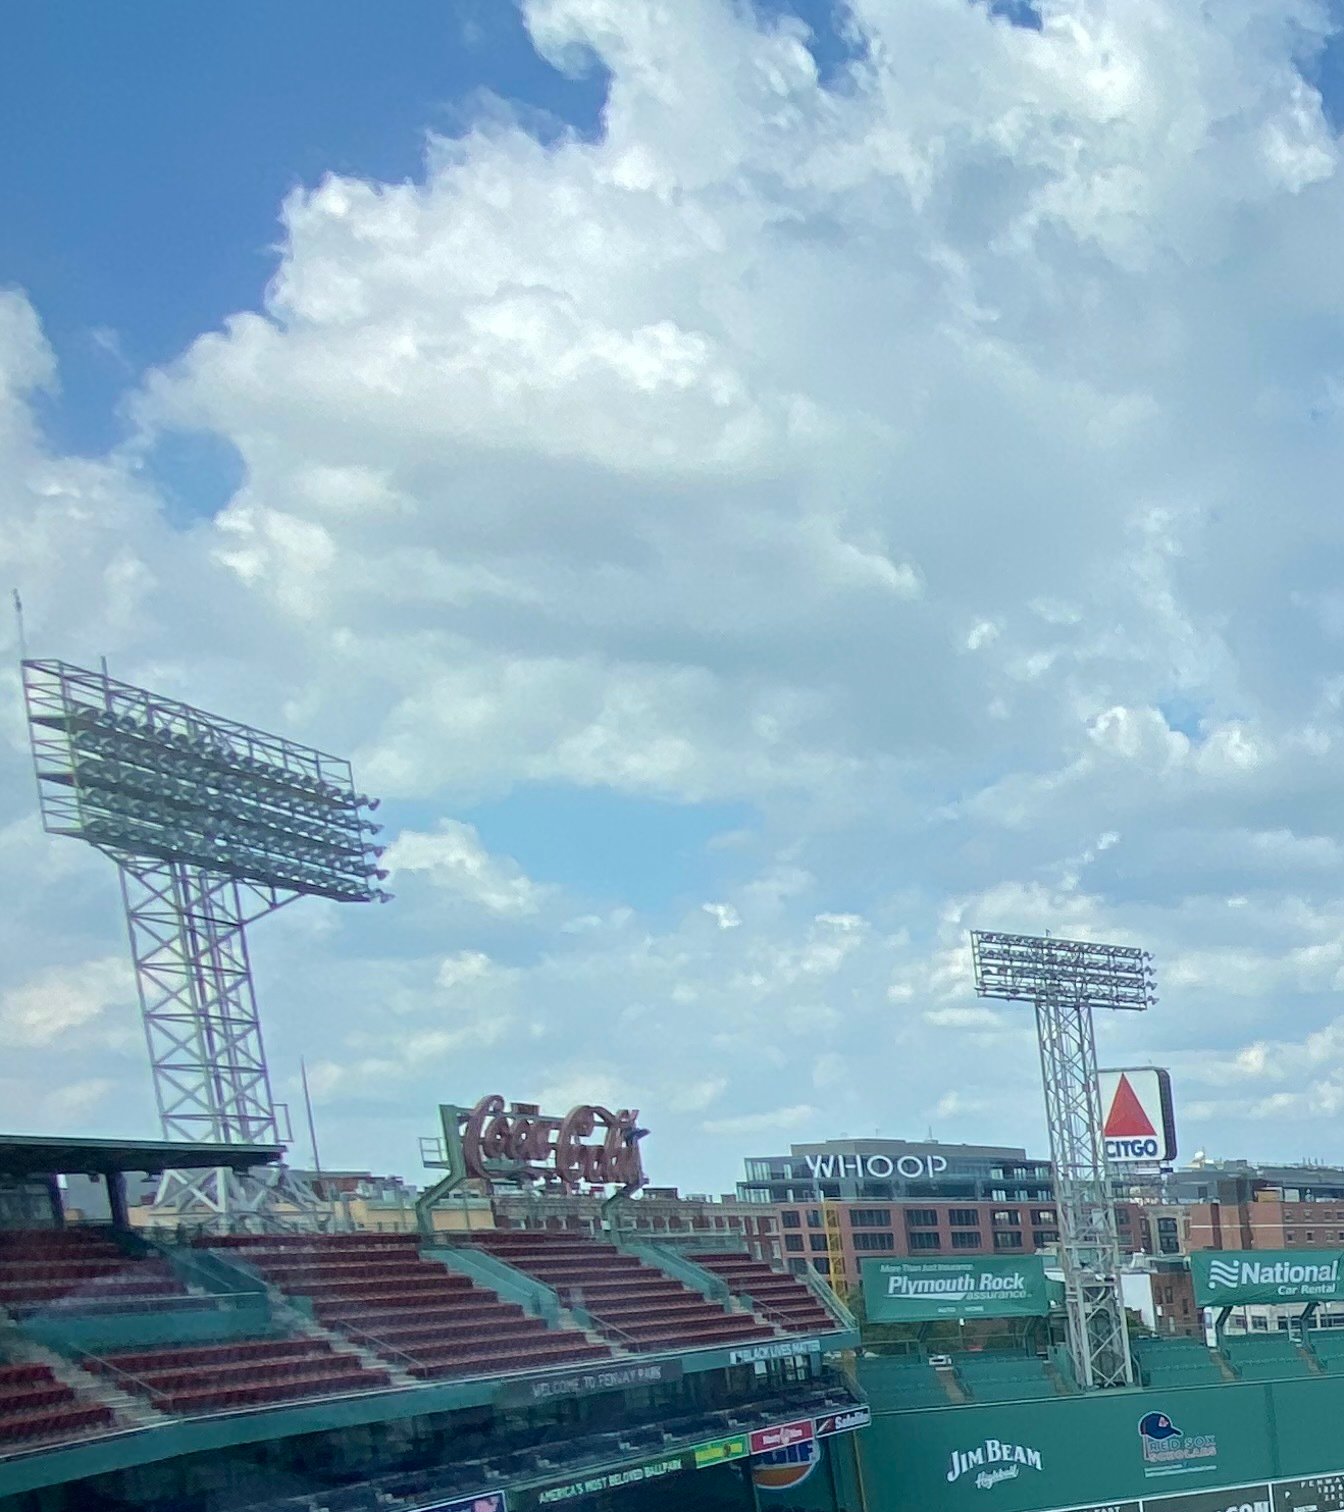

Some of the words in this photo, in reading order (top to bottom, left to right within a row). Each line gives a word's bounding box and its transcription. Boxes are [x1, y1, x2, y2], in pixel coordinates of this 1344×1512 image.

[1105, 1139, 1157, 1157] CITGO
[805, 1154, 948, 1179] WHOOP
[888, 1273, 975, 1295] Plymouth
[979, 1272, 1025, 1291] Rock
[1241, 1259, 1338, 1285] National
[1277, 1285, 1298, 1296] Car
[1301, 1283, 1335, 1295] Rental
[532, 1378, 581, 1398] WELCOME
[583, 1376, 596, 1389] TO
[598, 1371, 636, 1389] FENWAY
[1149, 1439, 1180, 1452] RED
[1184, 1435, 1217, 1449] SOX
[947, 1447, 984, 1482] JIM
[985, 1439, 1042, 1471] BEAM
[539, 1483, 583, 1504] AMERICA'S
[585, 1477, 607, 1492] MOST
[609, 1469, 643, 1487] BELOVED
[644, 1459, 682, 1479] BALLPARK
